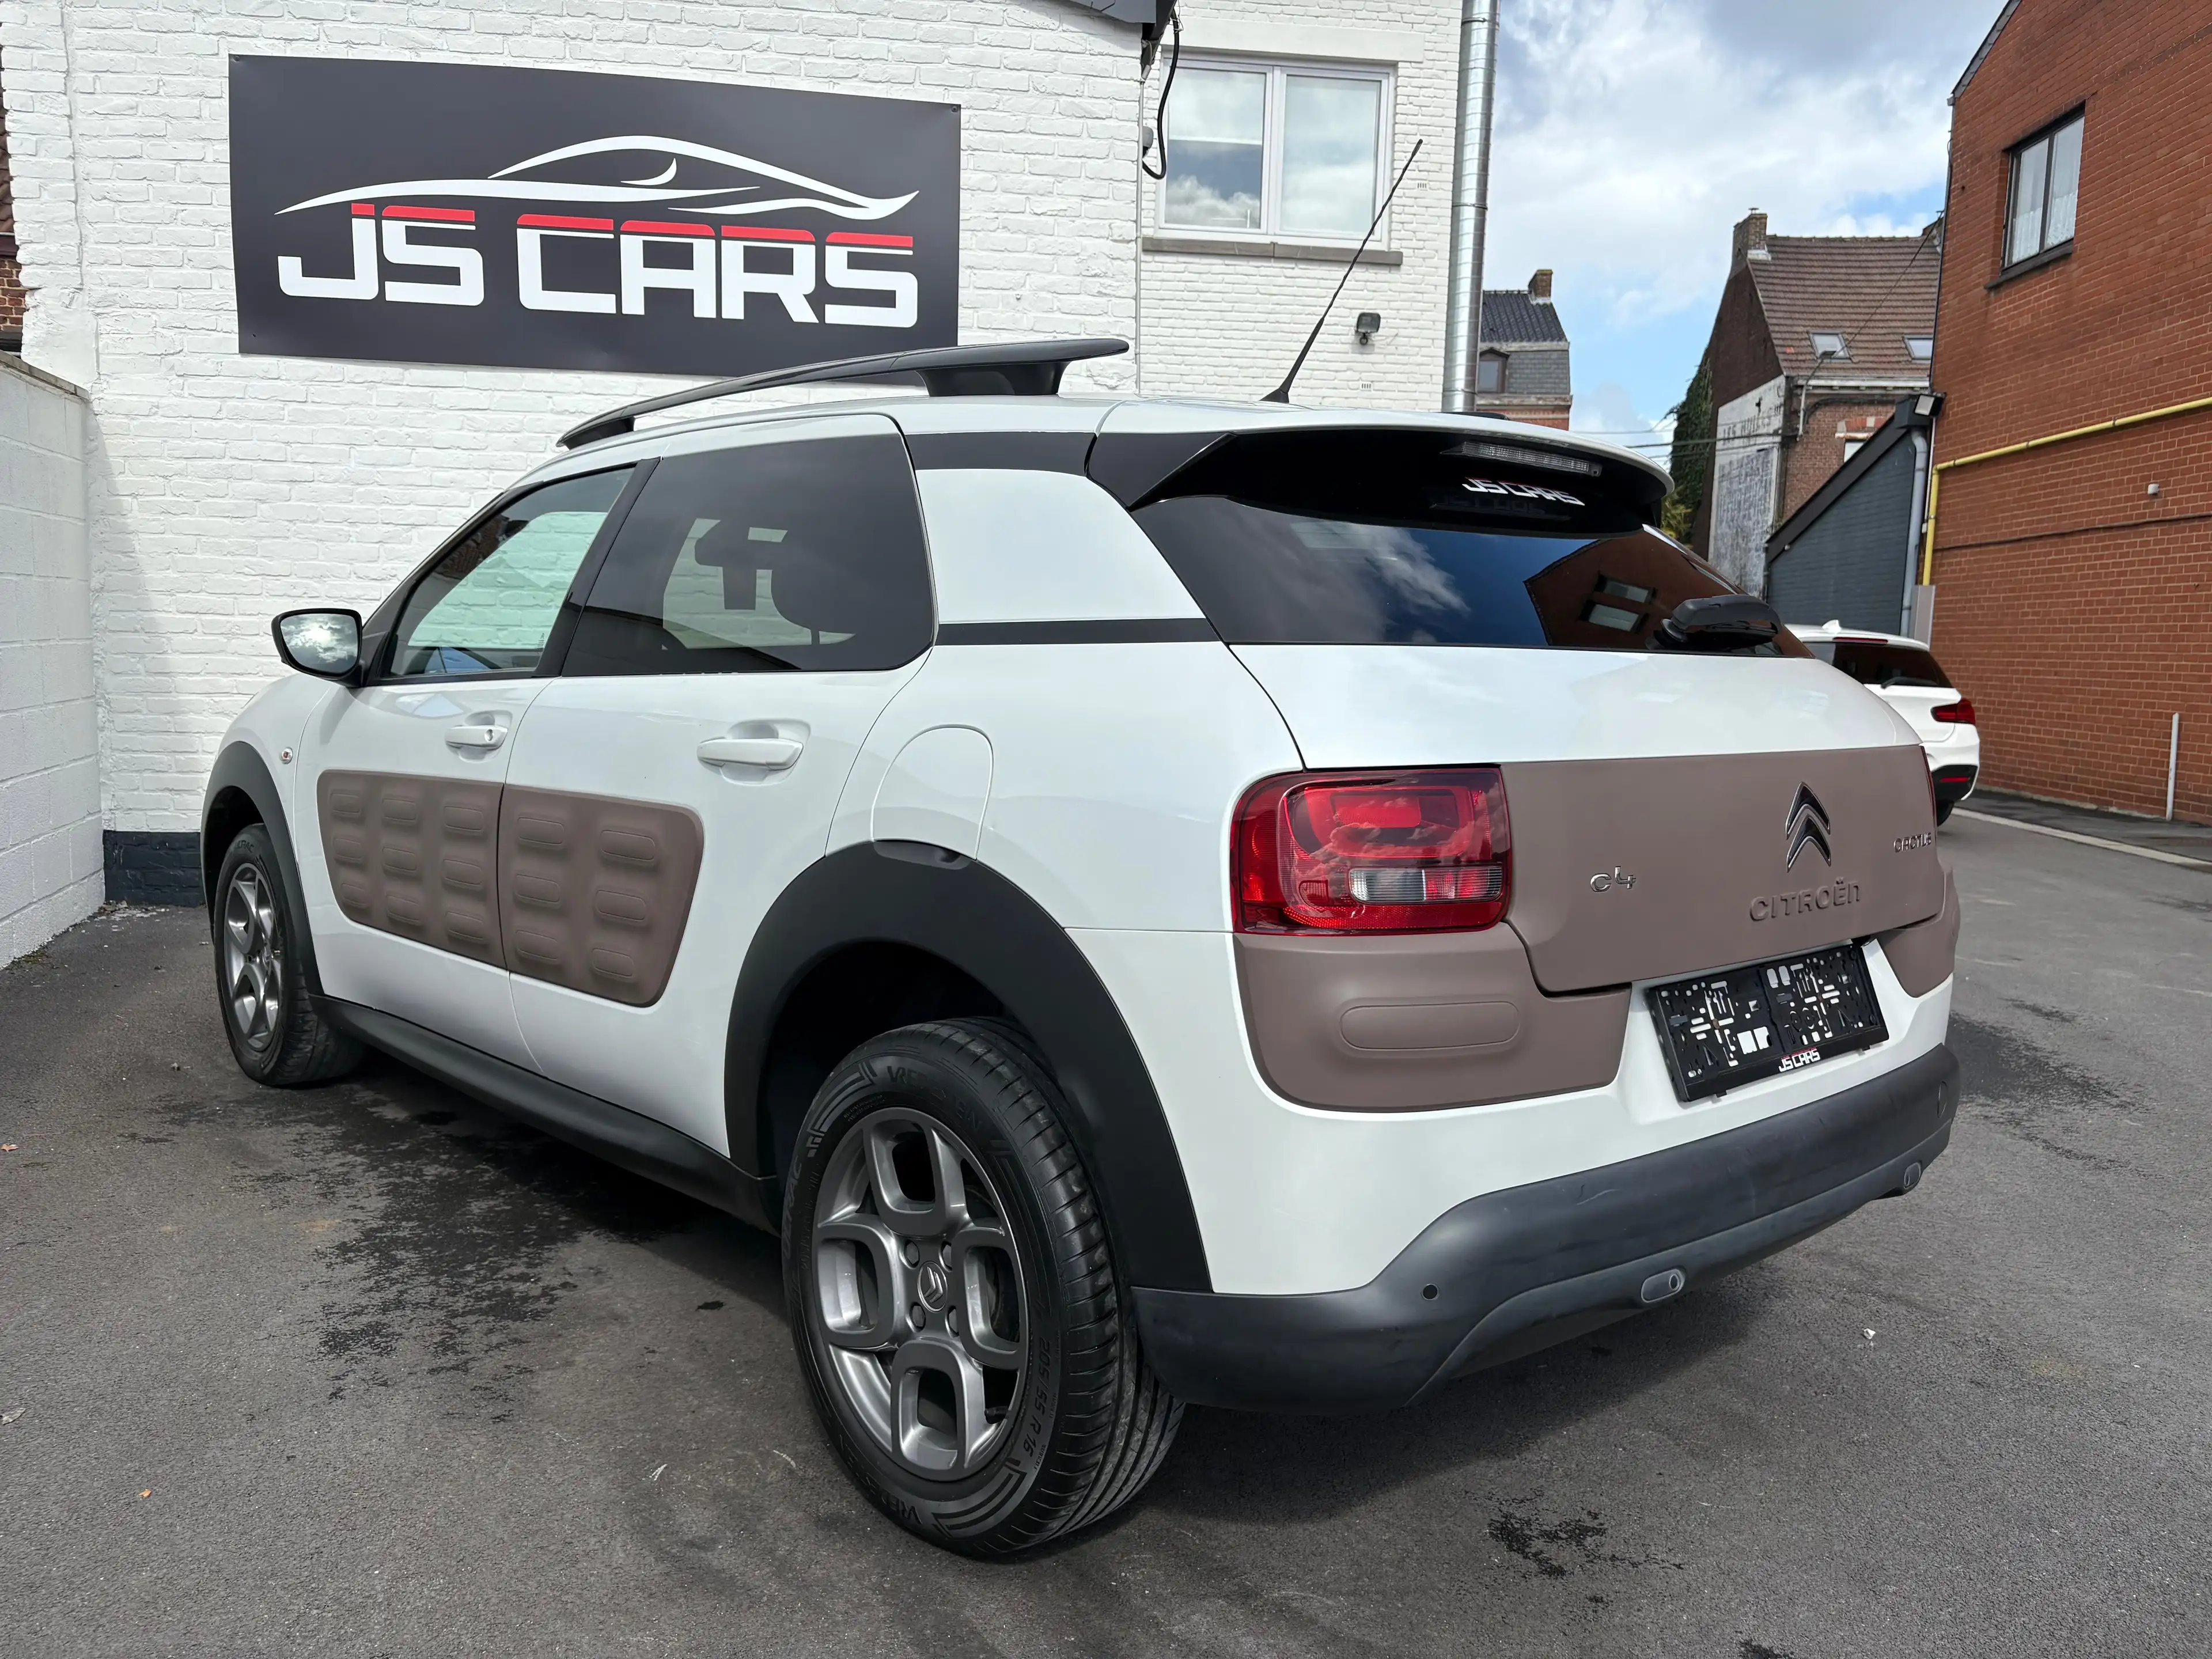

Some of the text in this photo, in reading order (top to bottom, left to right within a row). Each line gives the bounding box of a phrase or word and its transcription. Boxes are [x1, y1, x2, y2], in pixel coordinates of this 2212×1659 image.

[277, 203, 919, 328] JS CARS
[1462, 477, 1585, 506] JS CARS
[1893, 831, 1932, 853] CACTUS
[1589, 865, 1637, 893] C4
[1779, 1047, 1821, 1072] JS CARS
